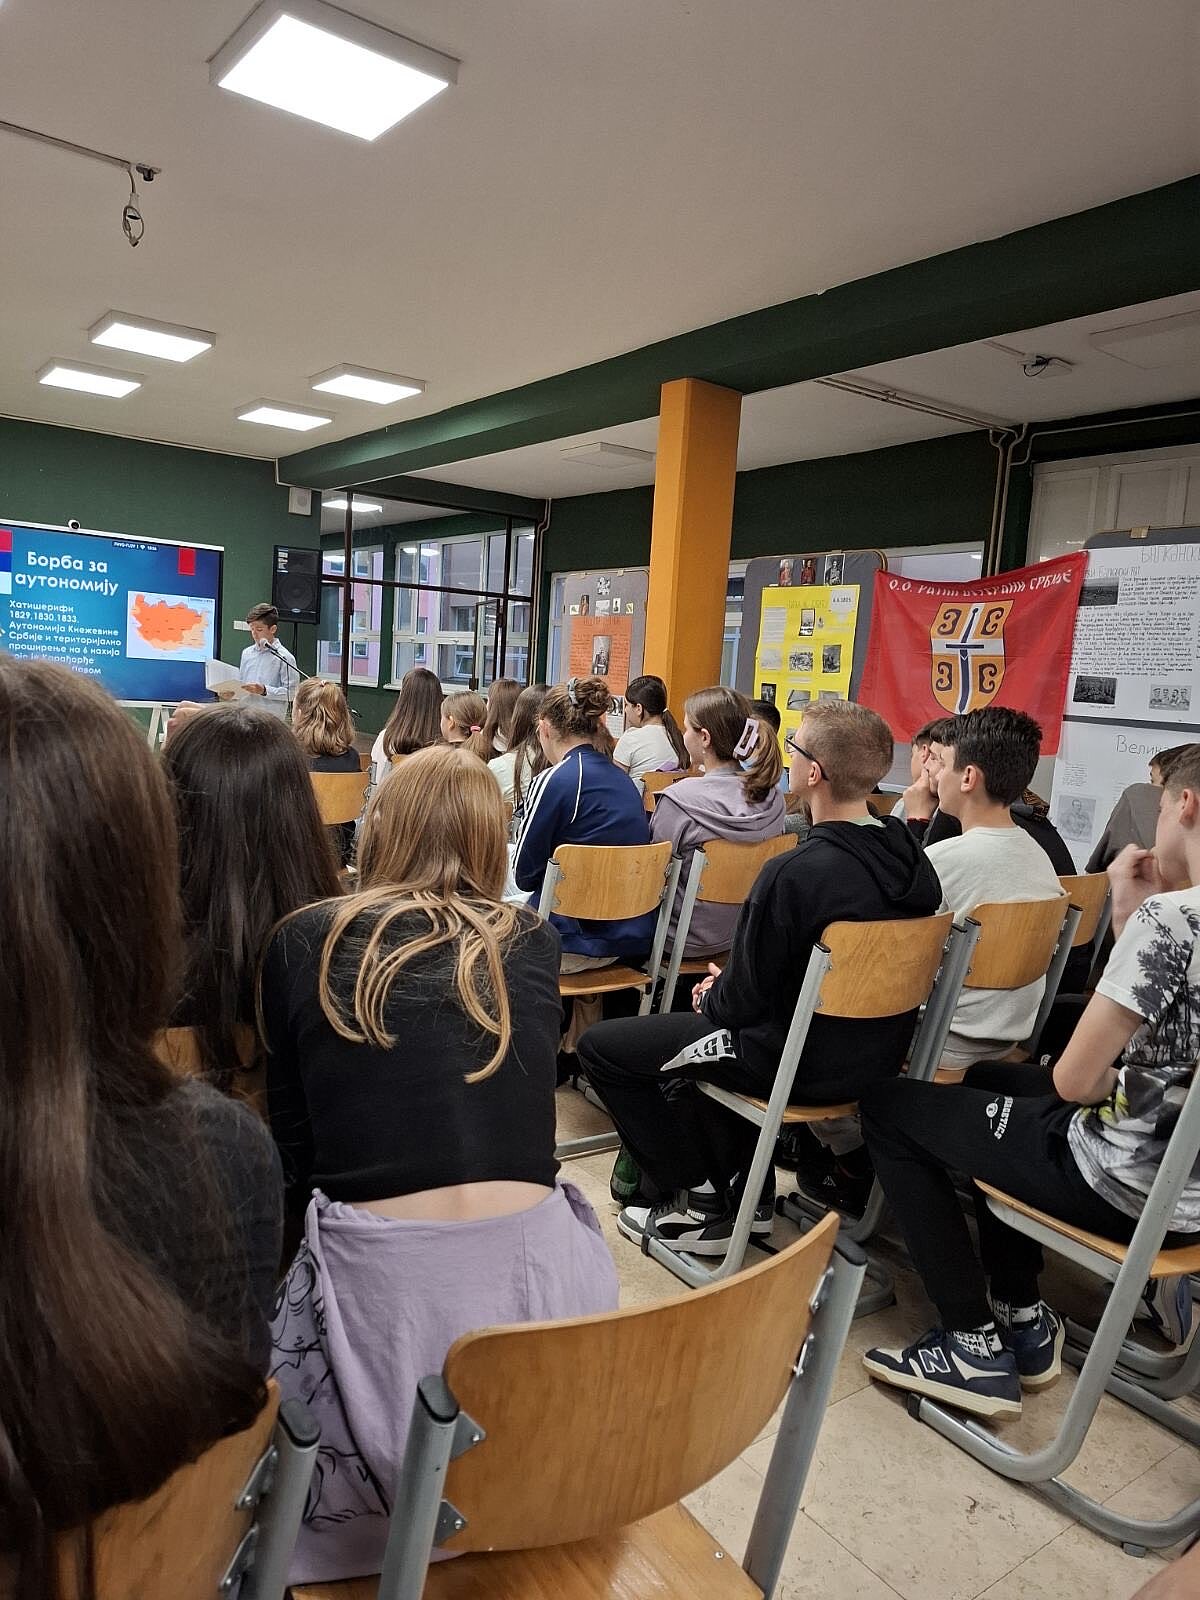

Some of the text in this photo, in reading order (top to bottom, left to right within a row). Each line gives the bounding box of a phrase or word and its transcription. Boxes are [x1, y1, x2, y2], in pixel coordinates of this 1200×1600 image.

[27, 551, 108, 573] Борба за
[15, 573, 119, 596] аутономију
[9, 599, 74, 613] Хатишерифи
[9, 621, 119, 636] Аутономија Кнежевине
[9, 631, 43, 642] Србије
[54, 635, 122, 646] територијално
[9, 643, 120, 657] проширење на 6 нахија
